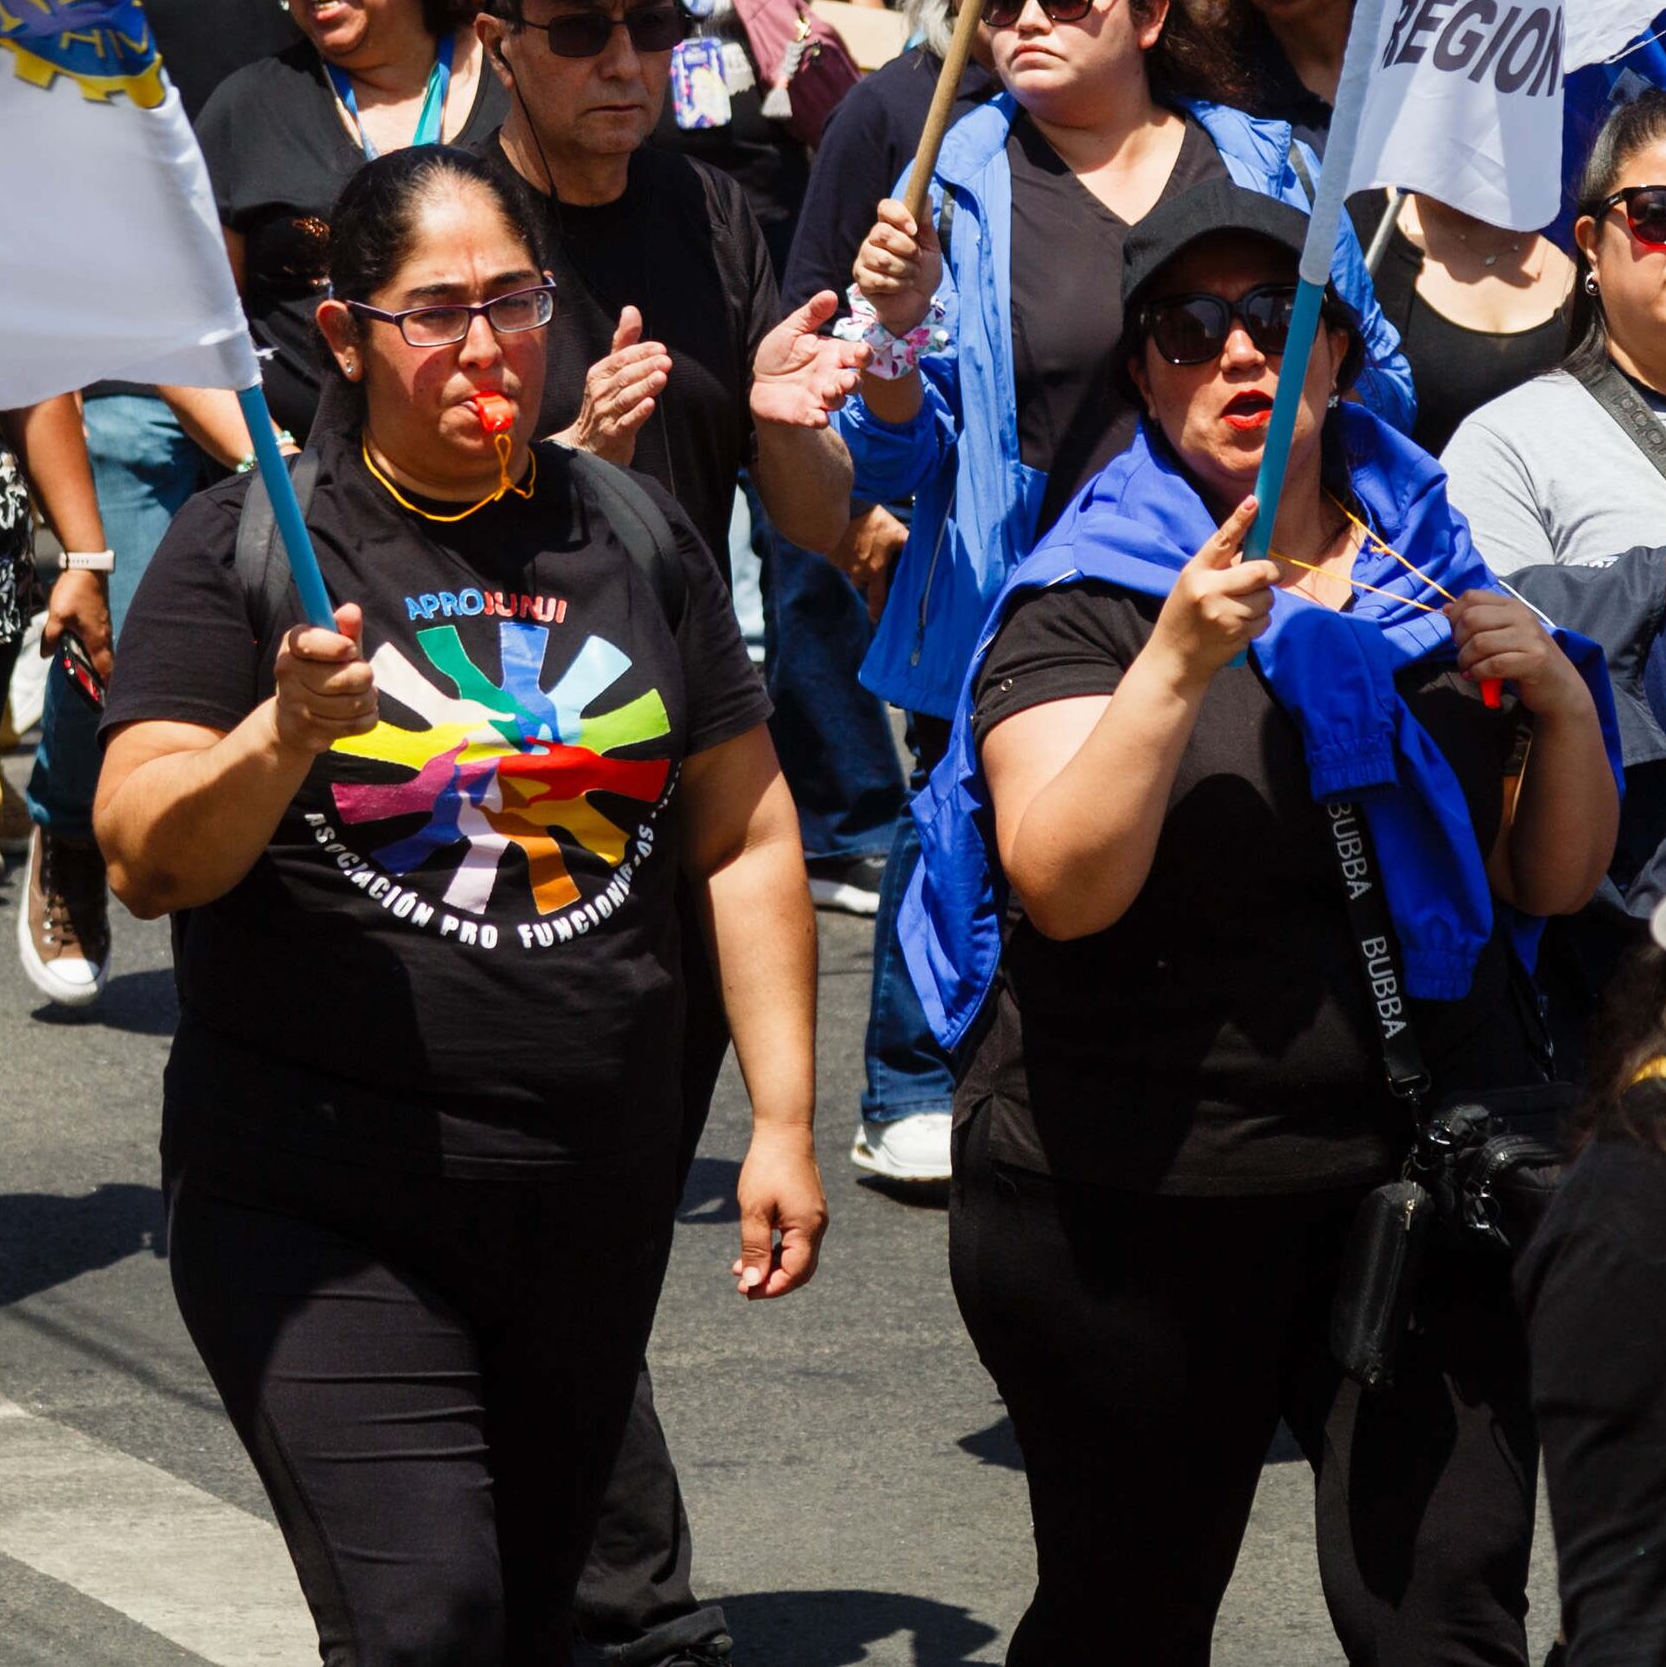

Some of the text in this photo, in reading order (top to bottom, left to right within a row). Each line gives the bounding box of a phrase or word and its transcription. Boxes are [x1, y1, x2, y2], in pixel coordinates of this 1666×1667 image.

[304, 811, 433, 930] ASOCIACIÓN
[441, 915, 499, 950] PRO
[1362, 935, 1407, 1039] BUBBA
